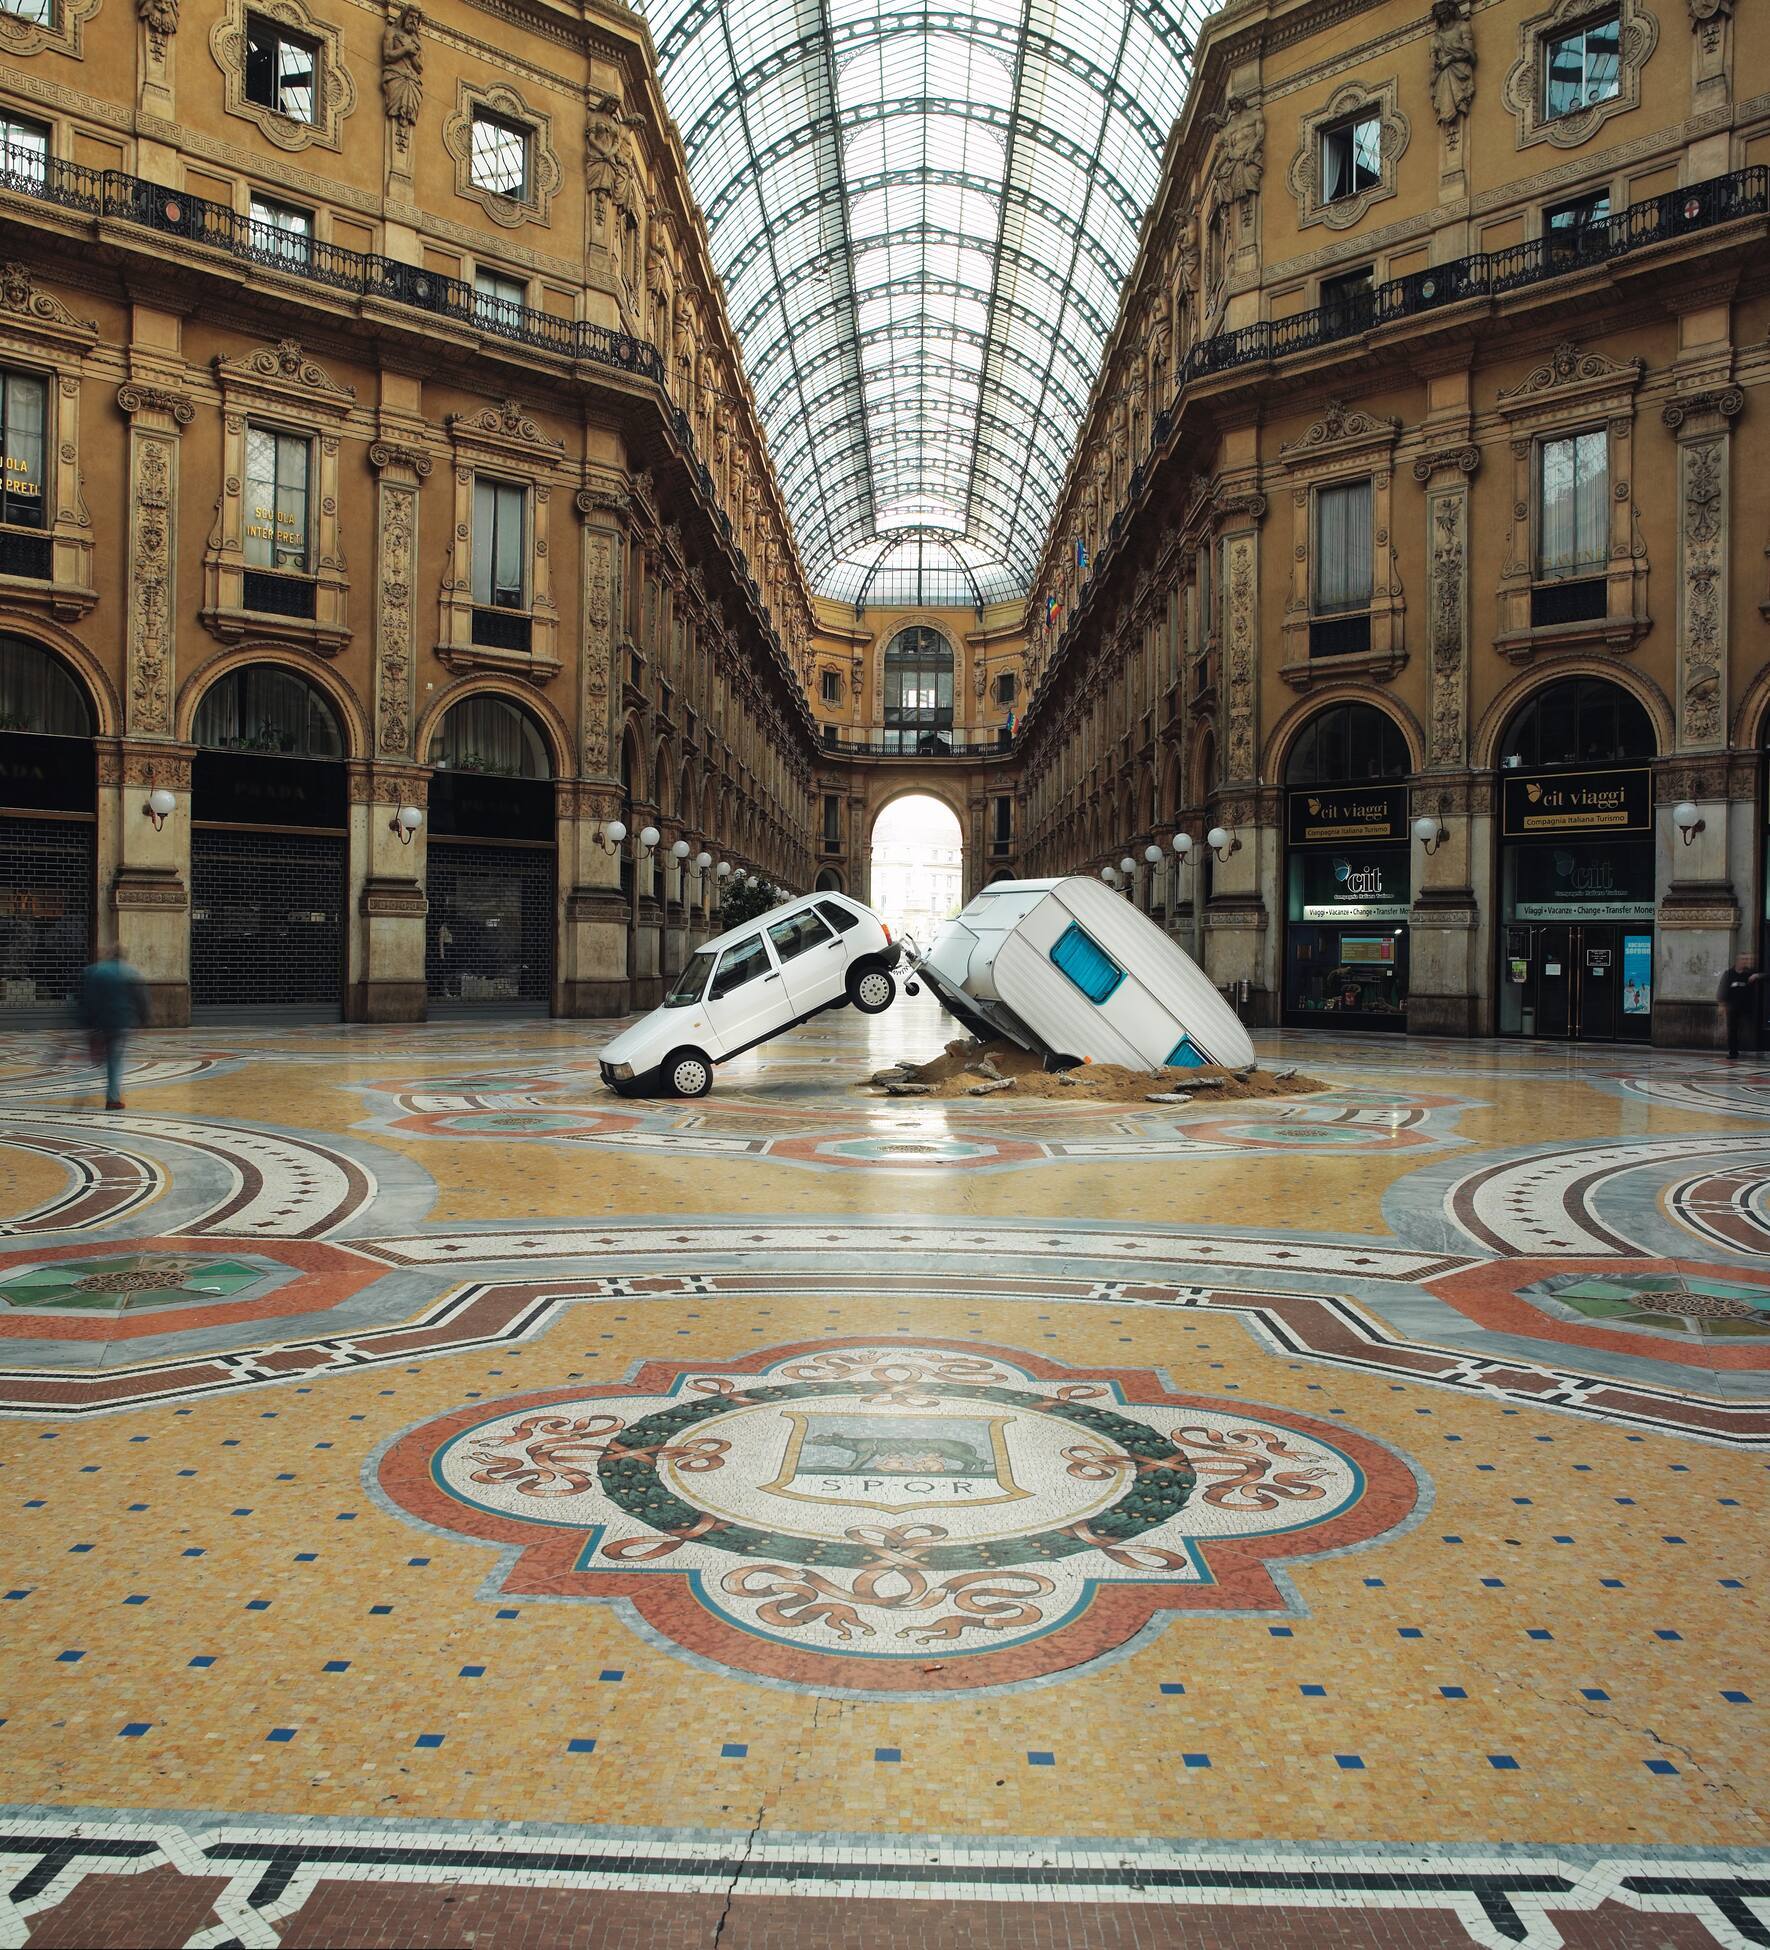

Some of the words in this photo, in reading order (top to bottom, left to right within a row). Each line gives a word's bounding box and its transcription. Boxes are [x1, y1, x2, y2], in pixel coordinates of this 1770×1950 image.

[1543, 790, 1563, 807] cit
[1570, 786, 1625, 809] viaggi
[1321, 804, 1337, 819] cit
[1343, 801, 1388, 821] viaggi
[1526, 817, 1566, 826] Compagnia
[1597, 814, 1625, 822] Turismo
[1307, 829, 1340, 837] Compagnia
[1347, 865, 1382, 893] cit
[1571, 859, 1614, 889] cit
[1309, 909, 1326, 917] Viaggi
[1353, 908, 1372, 917] Change
[1376, 907, 1398, 915] Transfer
[1524, 906, 1544, 916] Viaggi
[1548, 906, 1573, 914] Vacanze
[1577, 906, 1601, 916] Change
[1605, 905, 1632, 914] Transfer
